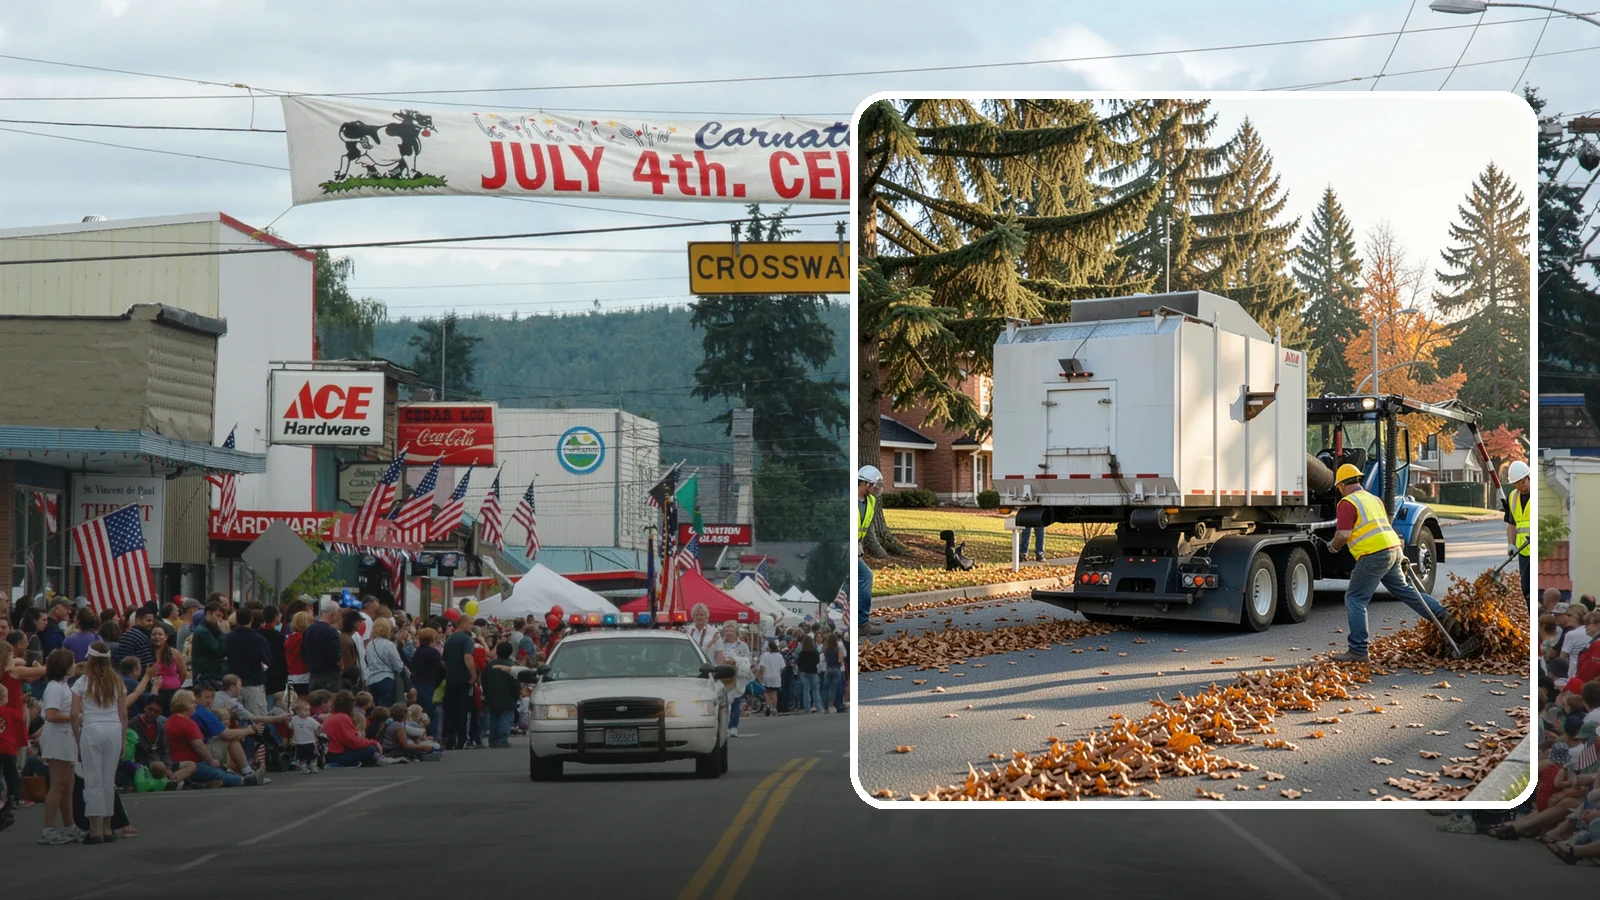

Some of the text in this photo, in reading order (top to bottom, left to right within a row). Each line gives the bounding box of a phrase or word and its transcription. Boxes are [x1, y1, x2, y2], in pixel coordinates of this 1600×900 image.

[481, 141, 605, 192] JULY
[632, 150, 747, 198] 4th.
[697, 254, 850, 280] CROSSWA
[282, 380, 373, 420] ACE
[406, 410, 452, 422] CEDAR
[283, 421, 370, 436] Hardware
[353, 467, 386, 480] Simpl
[95, 485, 124, 495] Vincent
[126, 486, 136, 495] de
[137, 486, 155, 495] Paul
[81, 503, 154, 522] THT
[688, 526, 741, 535] CRNATION
[699, 535, 731, 543] GLASS
